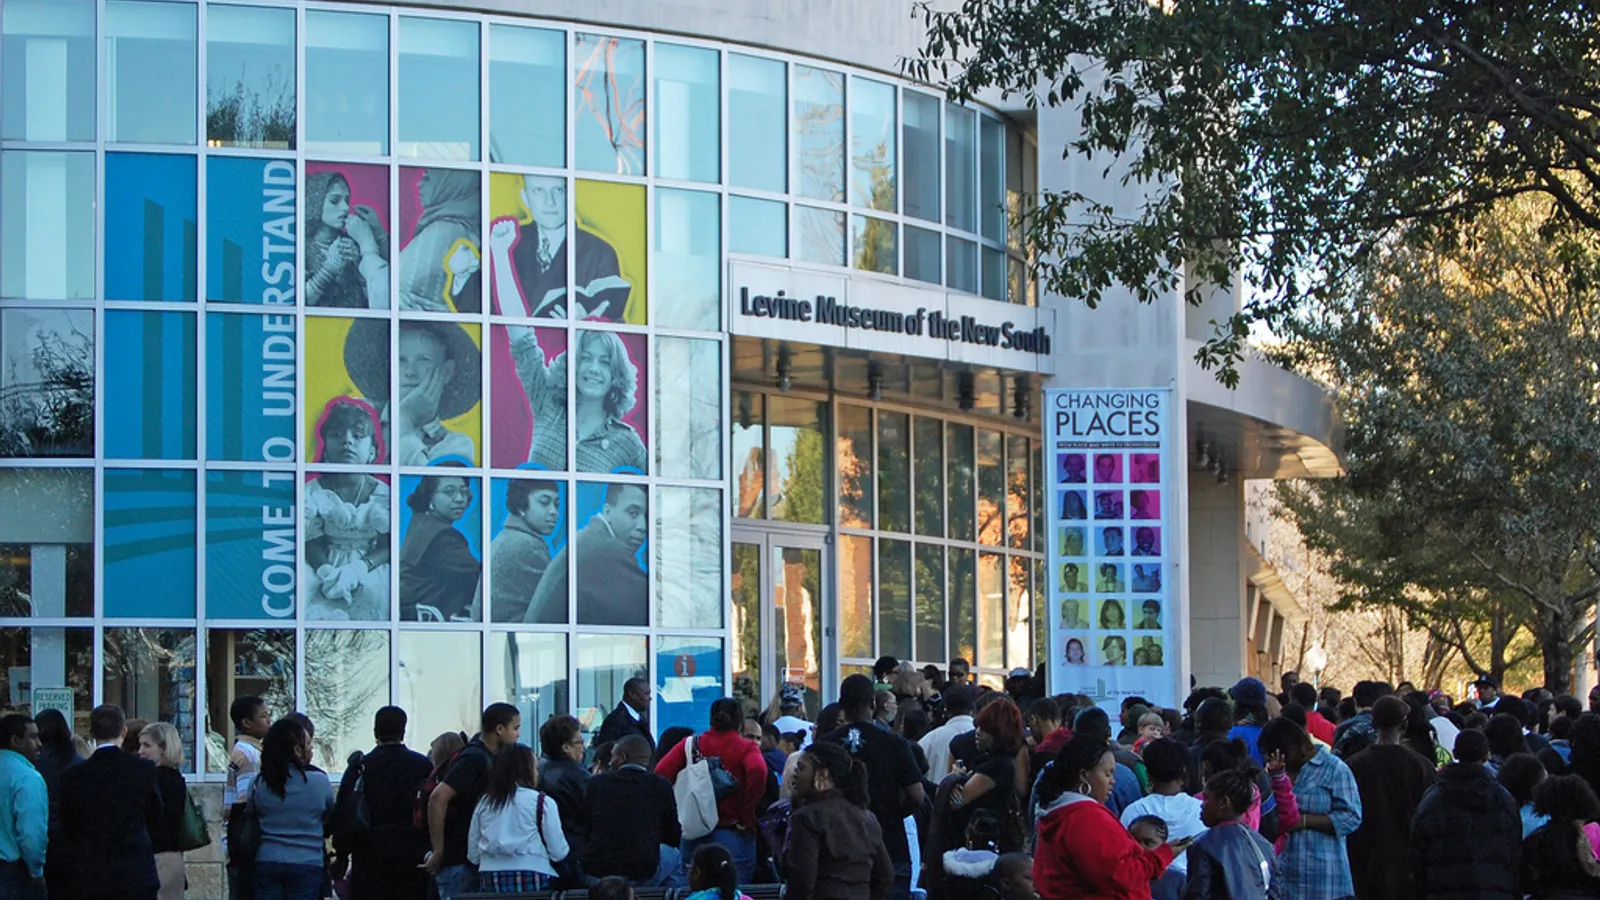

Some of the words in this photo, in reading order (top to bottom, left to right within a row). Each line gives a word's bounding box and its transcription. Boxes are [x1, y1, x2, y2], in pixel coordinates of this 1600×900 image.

[261, 160, 295, 417] UNDERSTAND
[740, 286, 812, 322] Levine
[815, 295, 904, 333] Museum
[905, 307, 926, 336] of
[928, 310, 961, 342] the
[961, 315, 1001, 347] New
[1001, 321, 1051, 355] South
[1056, 393, 1160, 409] CHANGING
[1056, 411, 1160, 436] PLACES
[262, 436, 295, 488] TO
[261, 505, 295, 618] COME
[36, 692, 71, 701] RESERVED
[38, 701, 70, 710] PARKING
